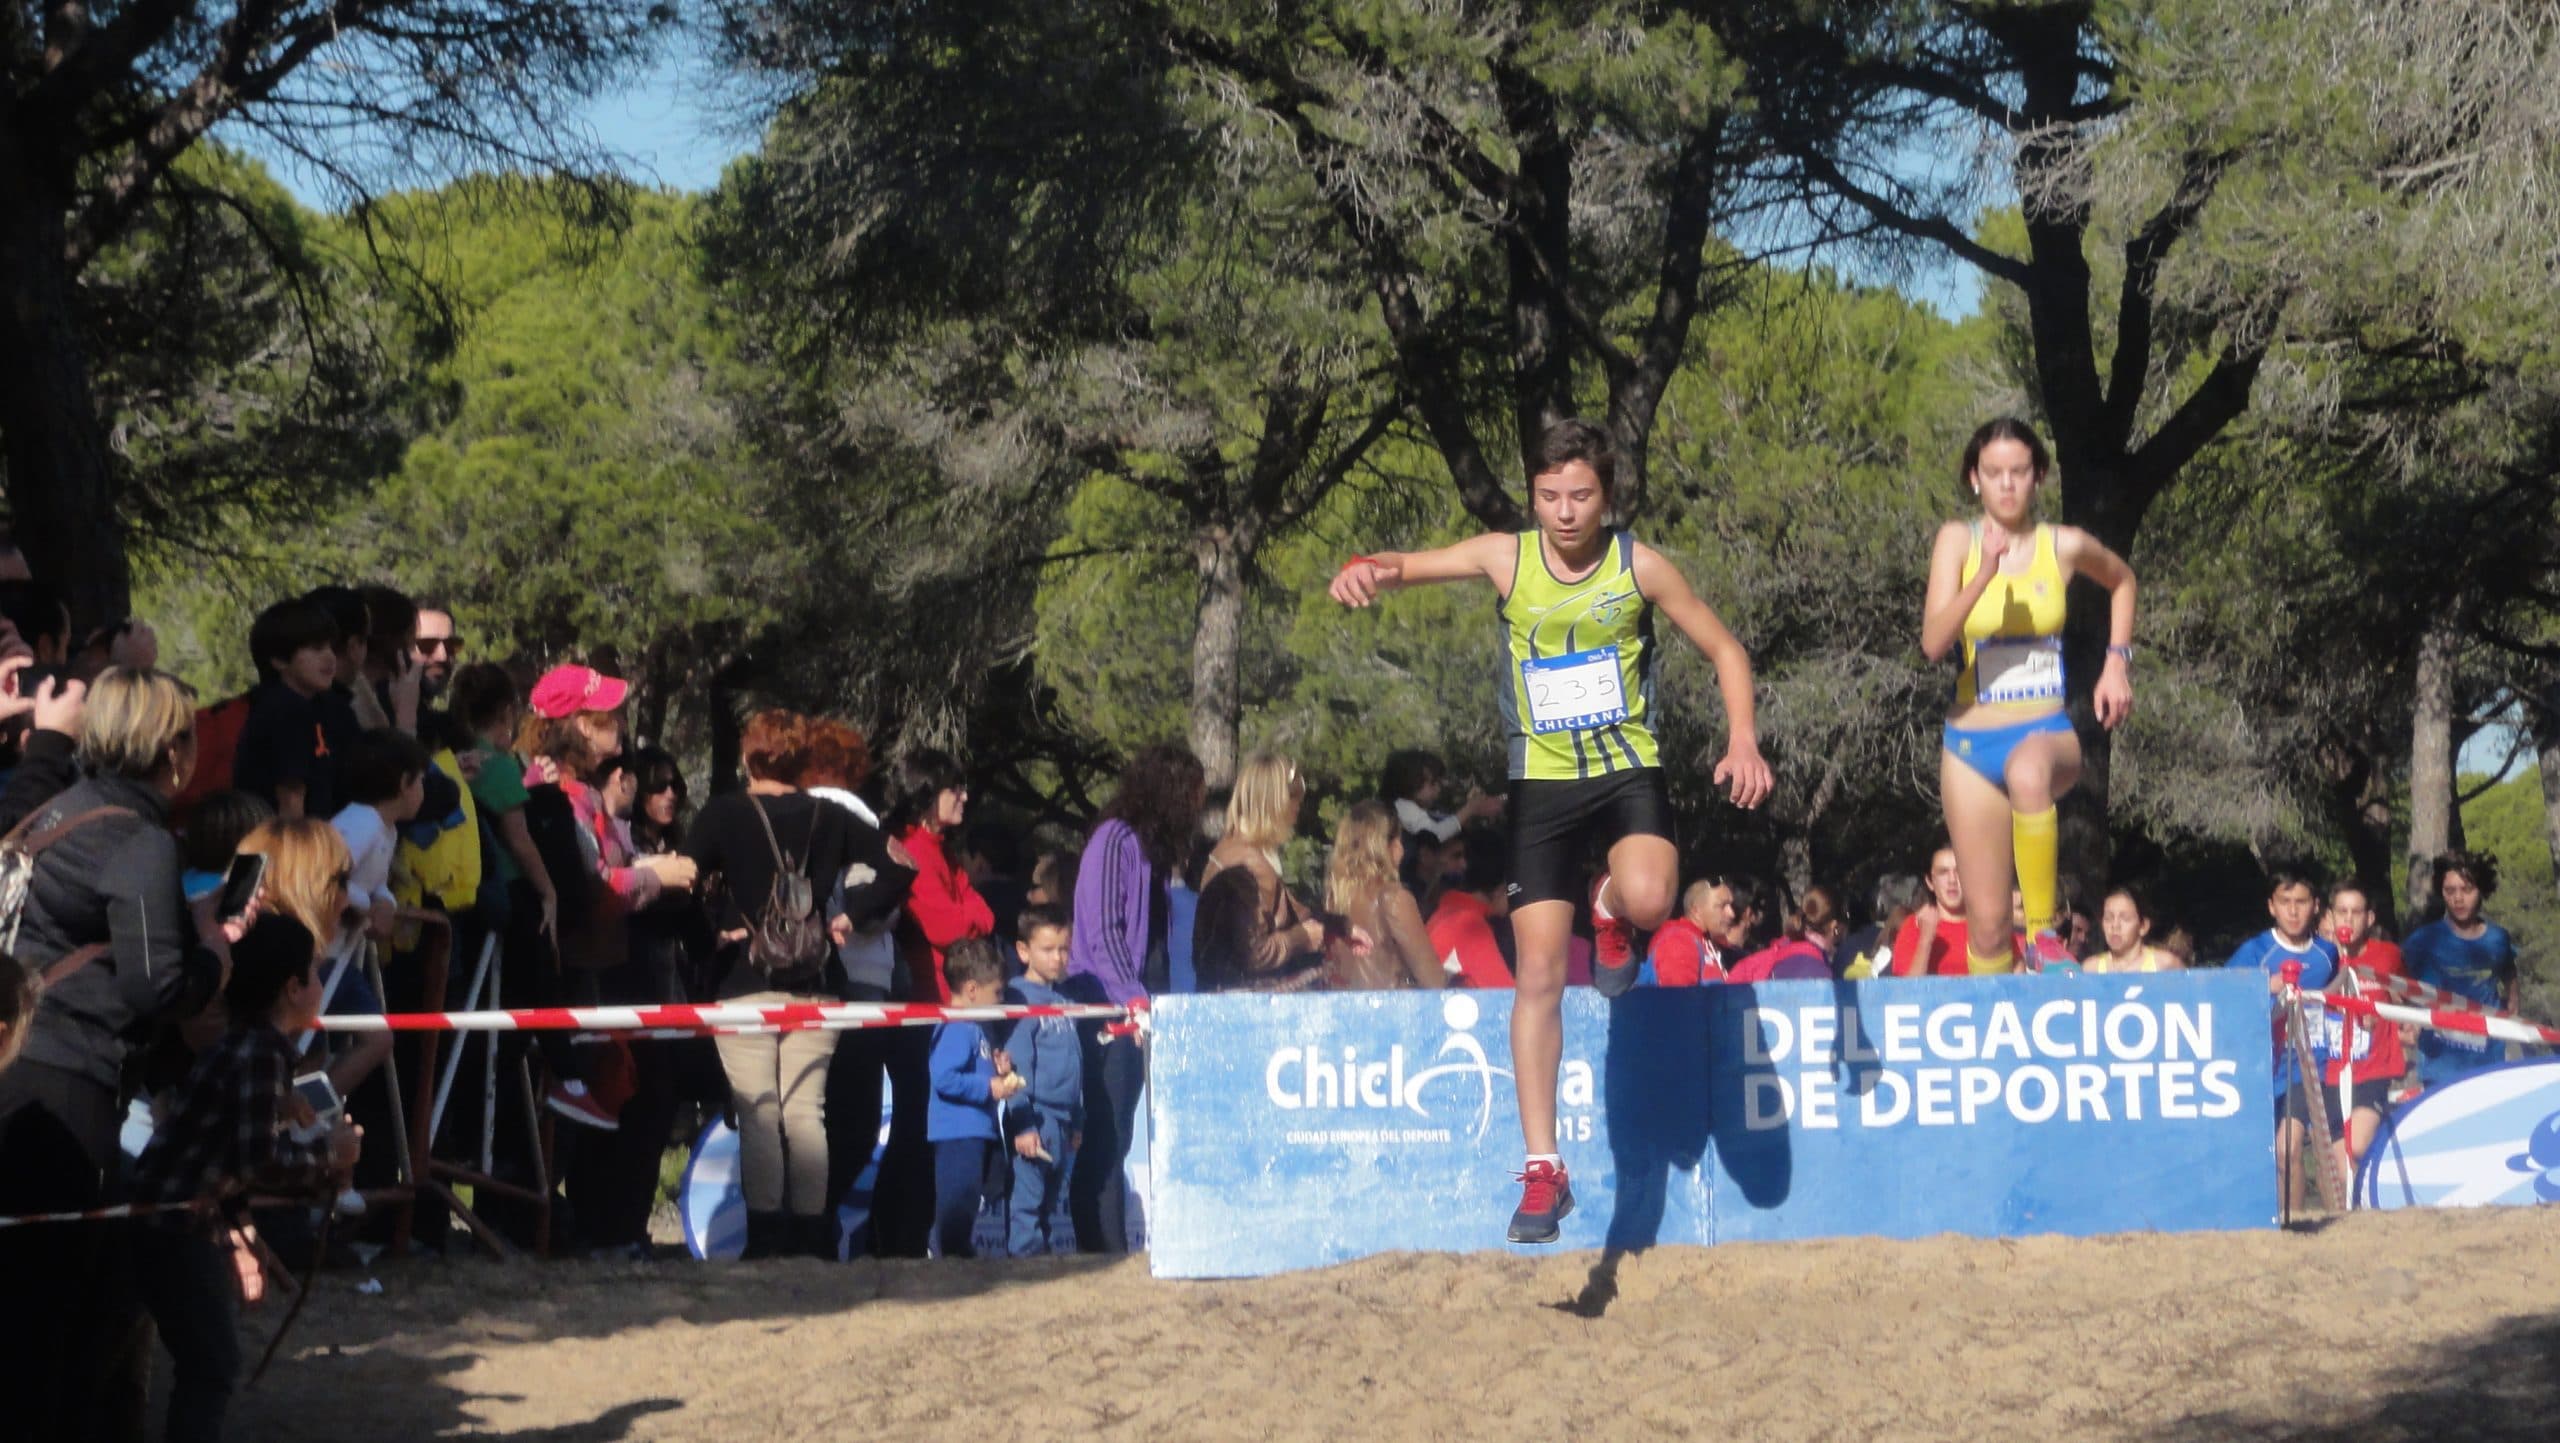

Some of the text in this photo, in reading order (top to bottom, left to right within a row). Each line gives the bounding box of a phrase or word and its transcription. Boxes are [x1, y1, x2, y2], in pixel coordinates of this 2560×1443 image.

[1535, 673, 1615, 707] 235
[1535, 708, 1626, 731] CHICLANA
[1743, 986, 2212, 1064] DELEGACIÓN
[1743, 1060, 2241, 1131] DE DEPORTES
[1286, 1130, 1328, 1144] CIUDAD
[1402, 1129, 1450, 1143] DEPORTE
